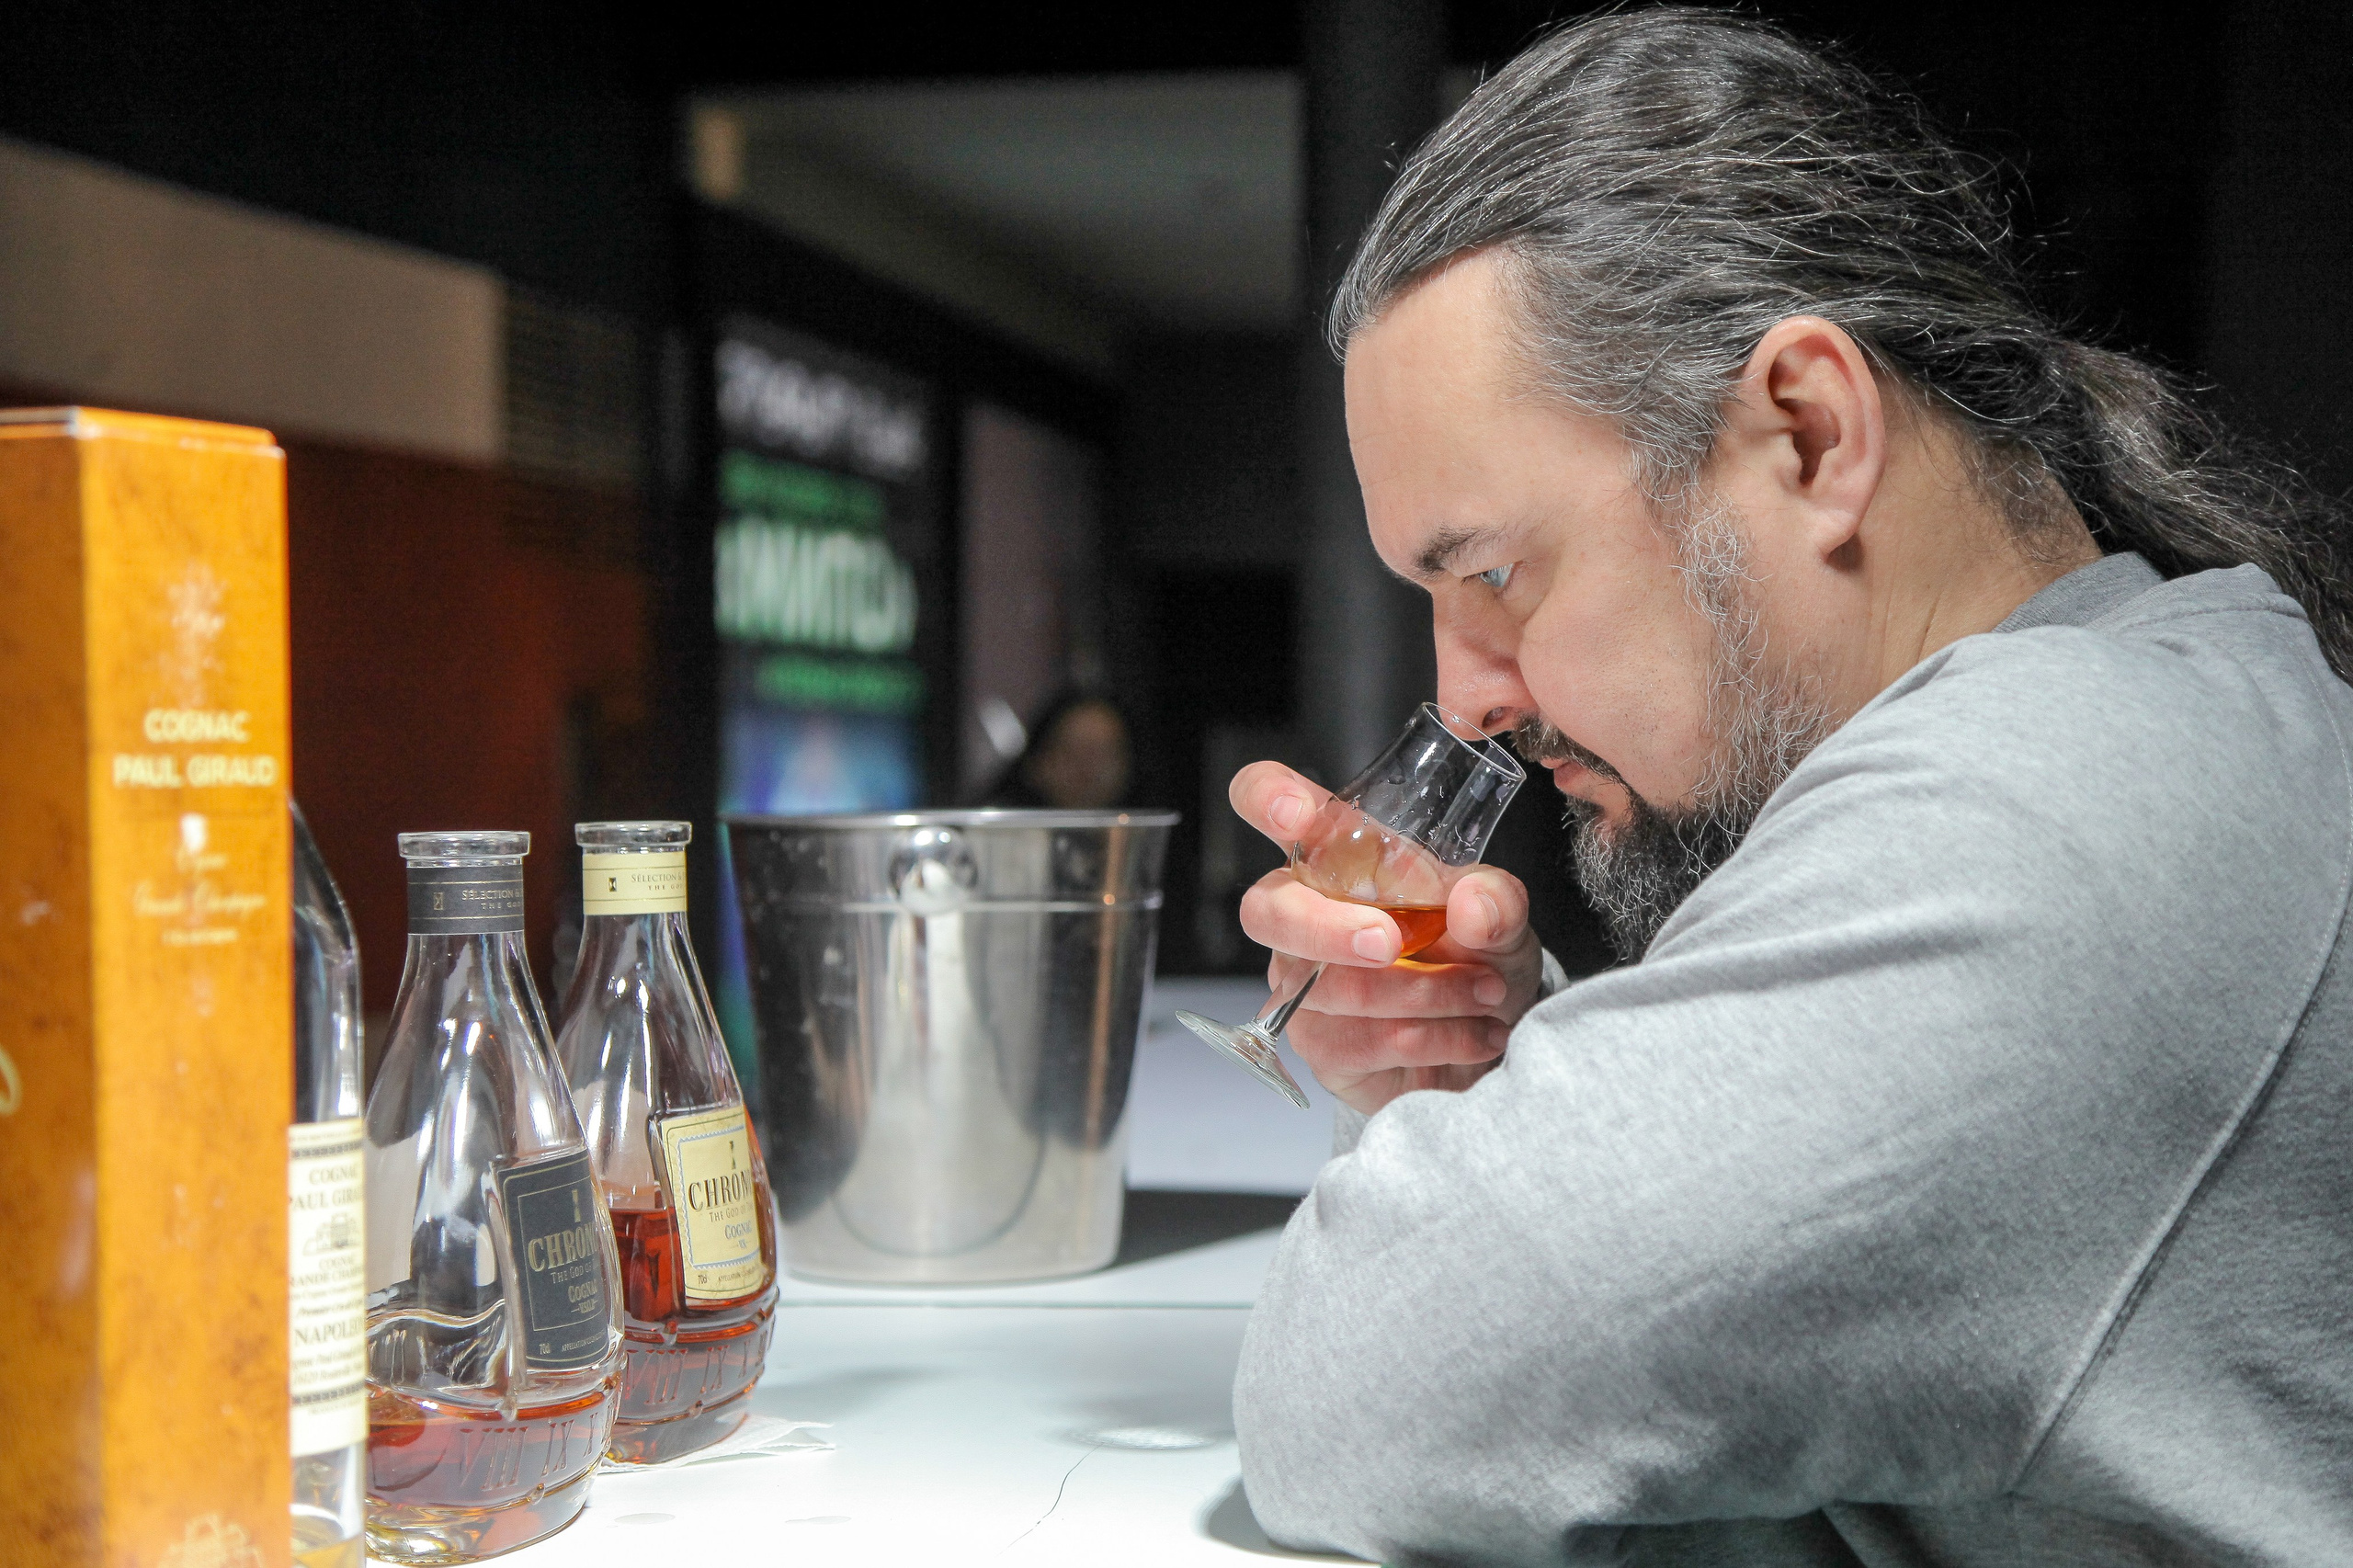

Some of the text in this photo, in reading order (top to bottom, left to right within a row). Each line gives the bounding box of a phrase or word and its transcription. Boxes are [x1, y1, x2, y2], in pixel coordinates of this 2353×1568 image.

[143, 709, 251, 743] COGNAC
[113, 753, 278, 789] PAUL GIRAUD
[688, 1168, 753, 1212] CHRON
[709, 1210, 724, 1222] THE
[527, 1221, 597, 1273] CHRON
[550, 1271, 568, 1284] THE
[569, 1265, 585, 1279] GOD
